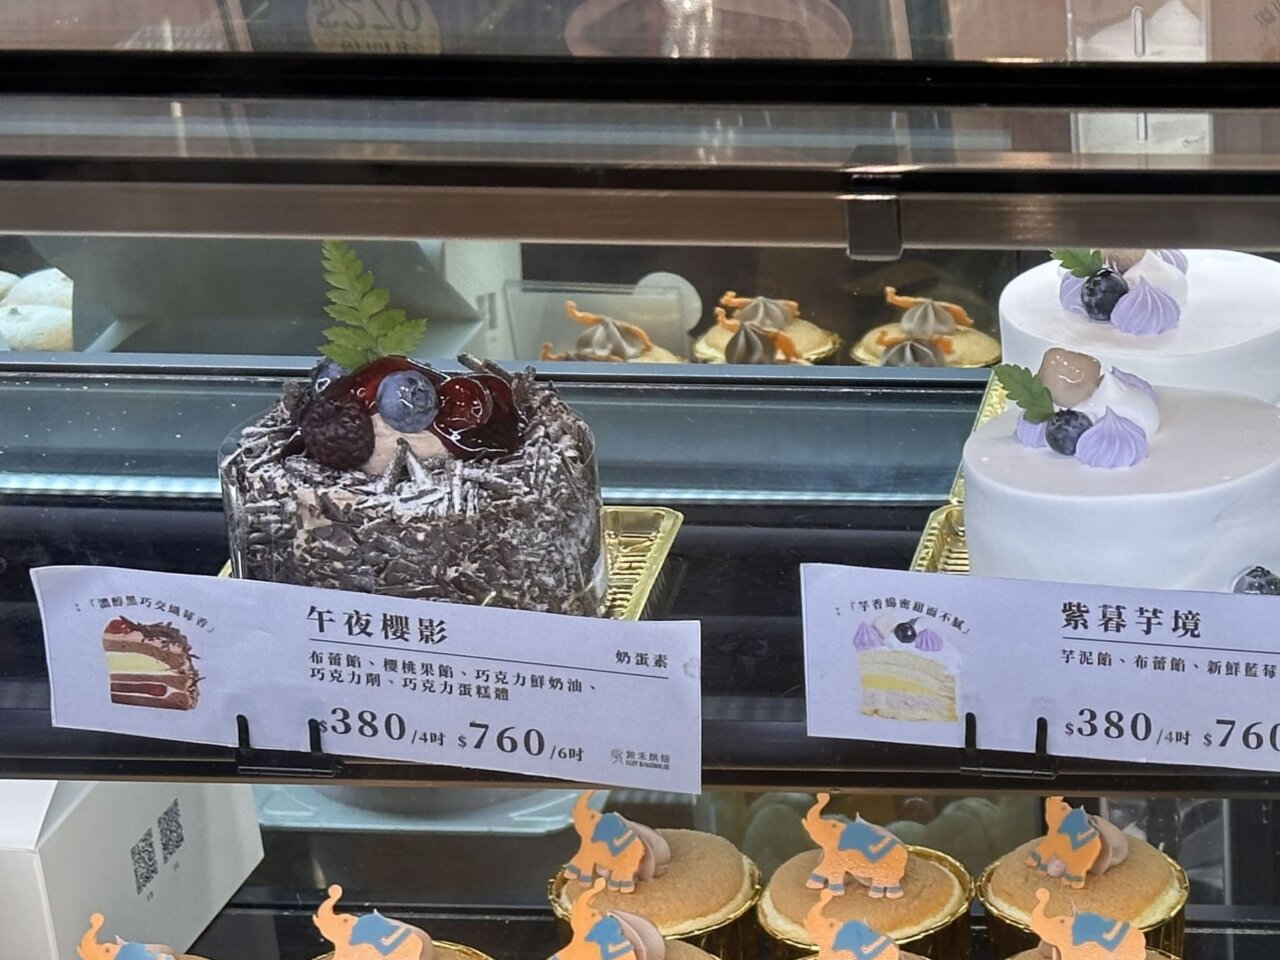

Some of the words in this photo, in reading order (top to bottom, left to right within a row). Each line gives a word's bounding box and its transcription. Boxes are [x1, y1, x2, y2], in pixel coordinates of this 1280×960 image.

[306, 605, 449, 645] 午夜櫻影
[1061, 602, 1202, 639] 紫暮芋境
[615, 649, 669, 670] 奶蛋素
[457, 721, 585, 763] $760/6吋
[1065, 708, 1192, 746] $380/4吋
